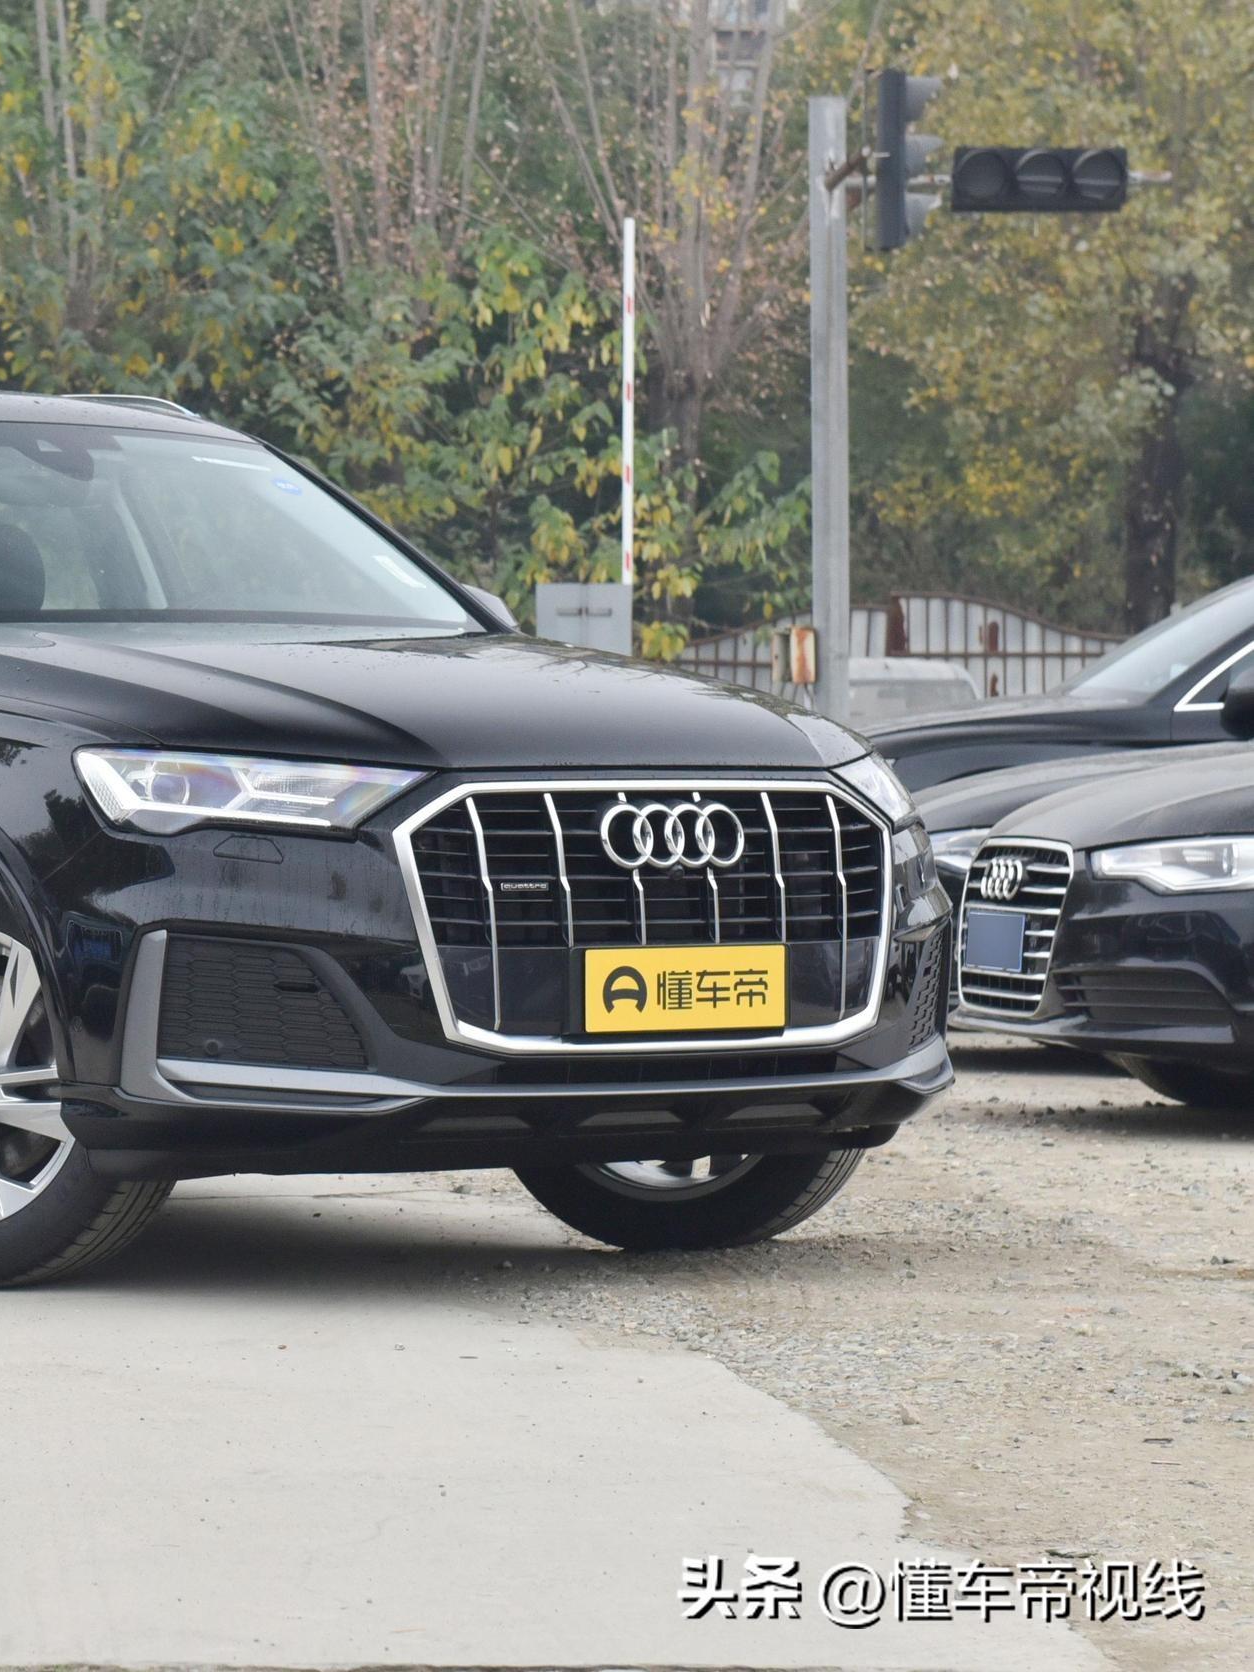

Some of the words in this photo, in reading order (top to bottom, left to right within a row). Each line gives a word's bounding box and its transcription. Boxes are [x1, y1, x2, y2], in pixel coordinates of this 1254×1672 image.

[503, 881, 547, 892] quattro
[657, 968, 768, 1010] 懂车帝
